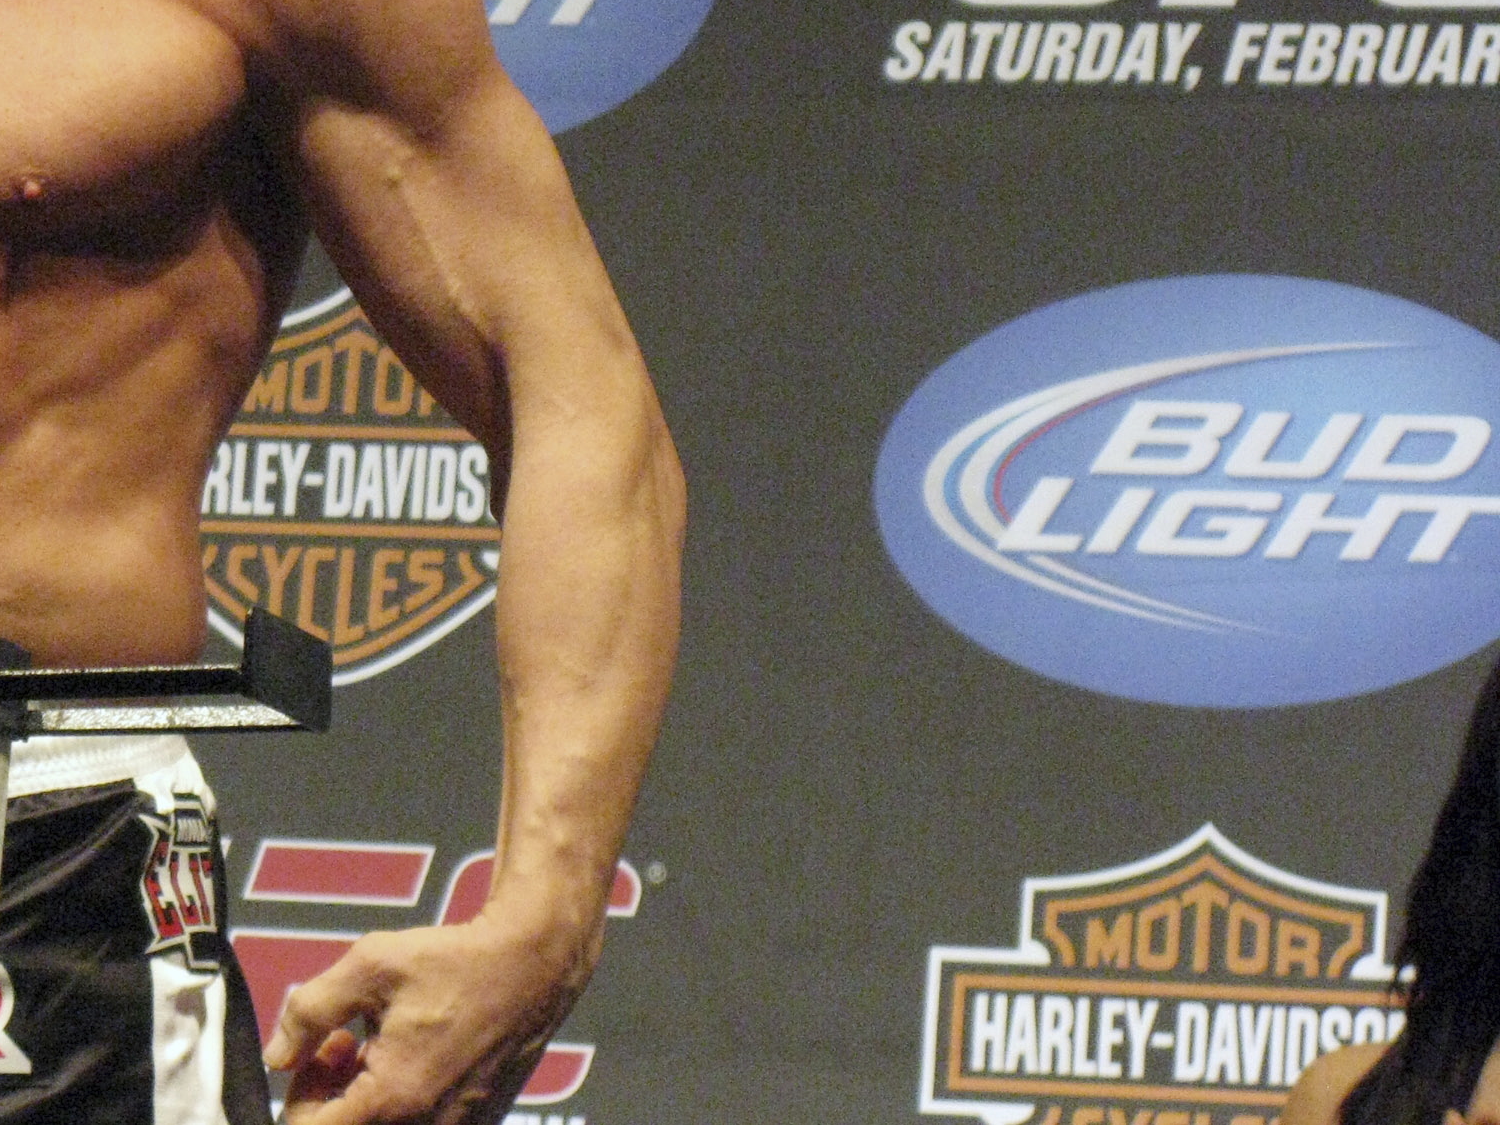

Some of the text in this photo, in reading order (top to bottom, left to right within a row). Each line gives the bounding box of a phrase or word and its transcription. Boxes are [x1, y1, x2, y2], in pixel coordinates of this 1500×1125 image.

[884, 20, 1202, 92] SATURDAY,
[242, 330, 437, 415] MOTO
[201, 441, 496, 523] RLEY-DAVIDS
[1090, 401, 1491, 482] BUD
[996, 477, 1500, 562] LIGHT
[227, 545, 445, 645] CYCLES
[1085, 880, 1321, 977] MOTOR
